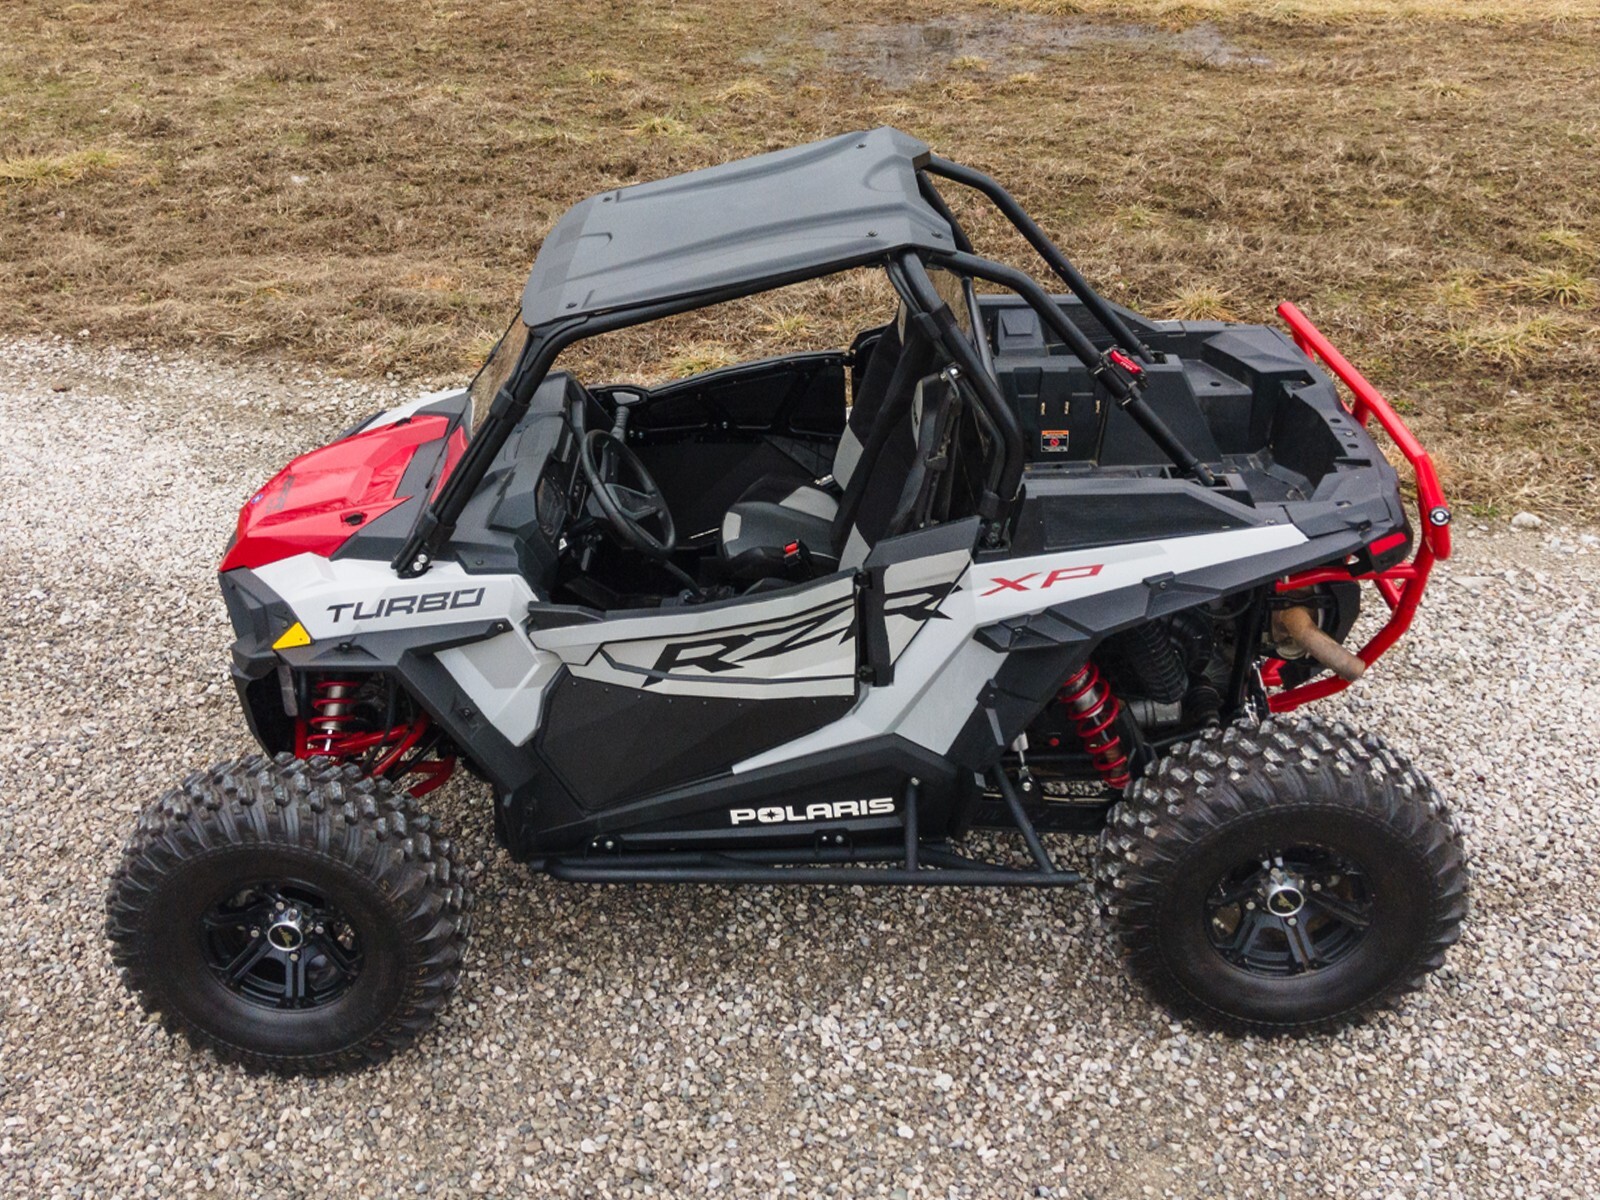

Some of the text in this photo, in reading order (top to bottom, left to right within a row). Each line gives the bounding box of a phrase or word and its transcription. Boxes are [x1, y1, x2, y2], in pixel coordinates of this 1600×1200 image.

[979, 564, 1104, 597] XP
[327, 587, 485, 623] TURBO
[641, 582, 963, 688] RZR
[730, 797, 896, 825] POLARIS
